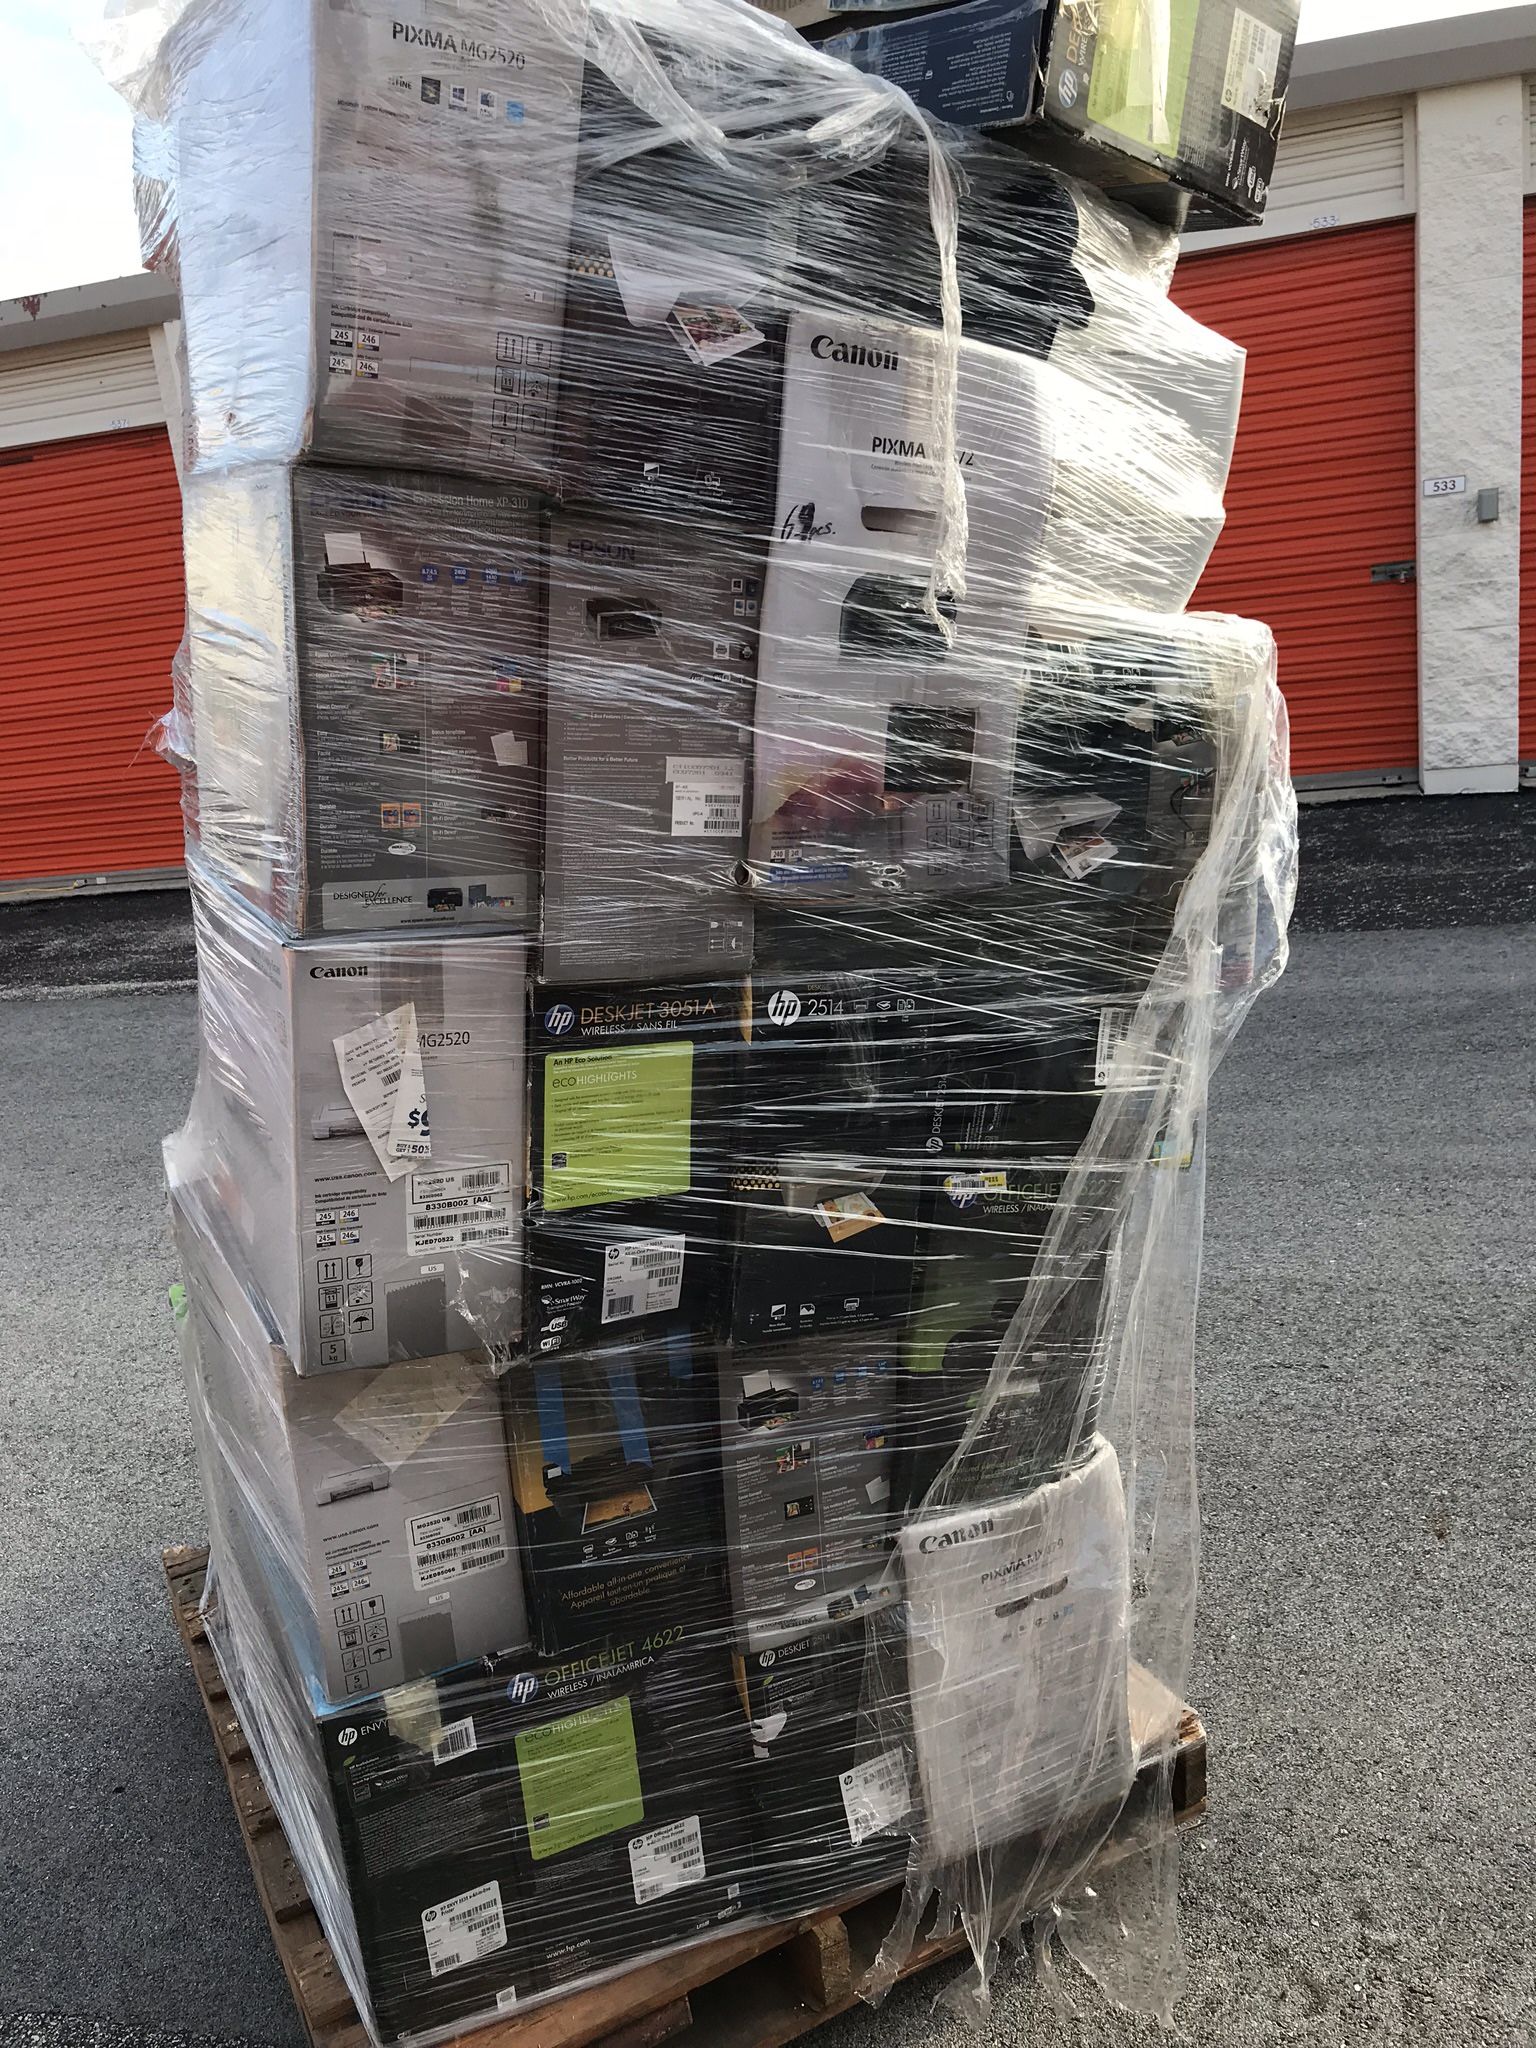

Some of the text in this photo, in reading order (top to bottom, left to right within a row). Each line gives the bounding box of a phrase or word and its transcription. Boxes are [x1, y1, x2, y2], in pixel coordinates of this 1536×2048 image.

[392, 22, 526, 71] PIXMA MG2520
[334, 330, 376, 344] 245 246
[809, 333, 899, 372] Canon
[872, 436, 926, 459] PIXMA
[1433, 479, 1457, 493] 533
[466, 494, 494, 508] Home
[333, 890, 375, 901] DESIGNED
[362, 895, 413, 908] EXCELLENCE
[309, 965, 368, 979] Canon
[767, 990, 844, 1026] hp 2514
[545, 1003, 575, 1035] hp
[581, 1002, 654, 1025] DESKJET
[581, 1023, 625, 1036] WIRELESS
[636, 1020, 663, 1032] SANS
[665, 1020, 678, 1030] FIL
[564, 1057, 574, 1065] HP
[575, 1056, 586, 1064] Eco
[552, 1070, 638, 1089] ecoHIGHLIGHTS
[425, 1199, 469, 1211] 8330B002
[983, 1203, 1020, 1214] WIRELESS
[319, 1210, 356, 1221] 245 246
[329, 1343, 337, 1354] 5
[426, 1533, 466, 1549] 8330B002
[918, 1518, 994, 1555] Canon
[331, 1560, 364, 1574] 245 246
[981, 1557, 1027, 1585] PIXMA
[562, 1581, 605, 1601] Affordable
[607, 1570, 643, 1588] all-in-one
[609, 1589, 650, 1608] abordable
[544, 1625, 684, 1688] OFFICEJET 4622
[778, 1640, 811, 1658] DESKJET
[506, 1671, 538, 1704] hp
[547, 1677, 589, 1701] WIRELESS
[338, 1719, 388, 1746] hp ENVY
[546, 1938, 591, 1959] www.hp.com
